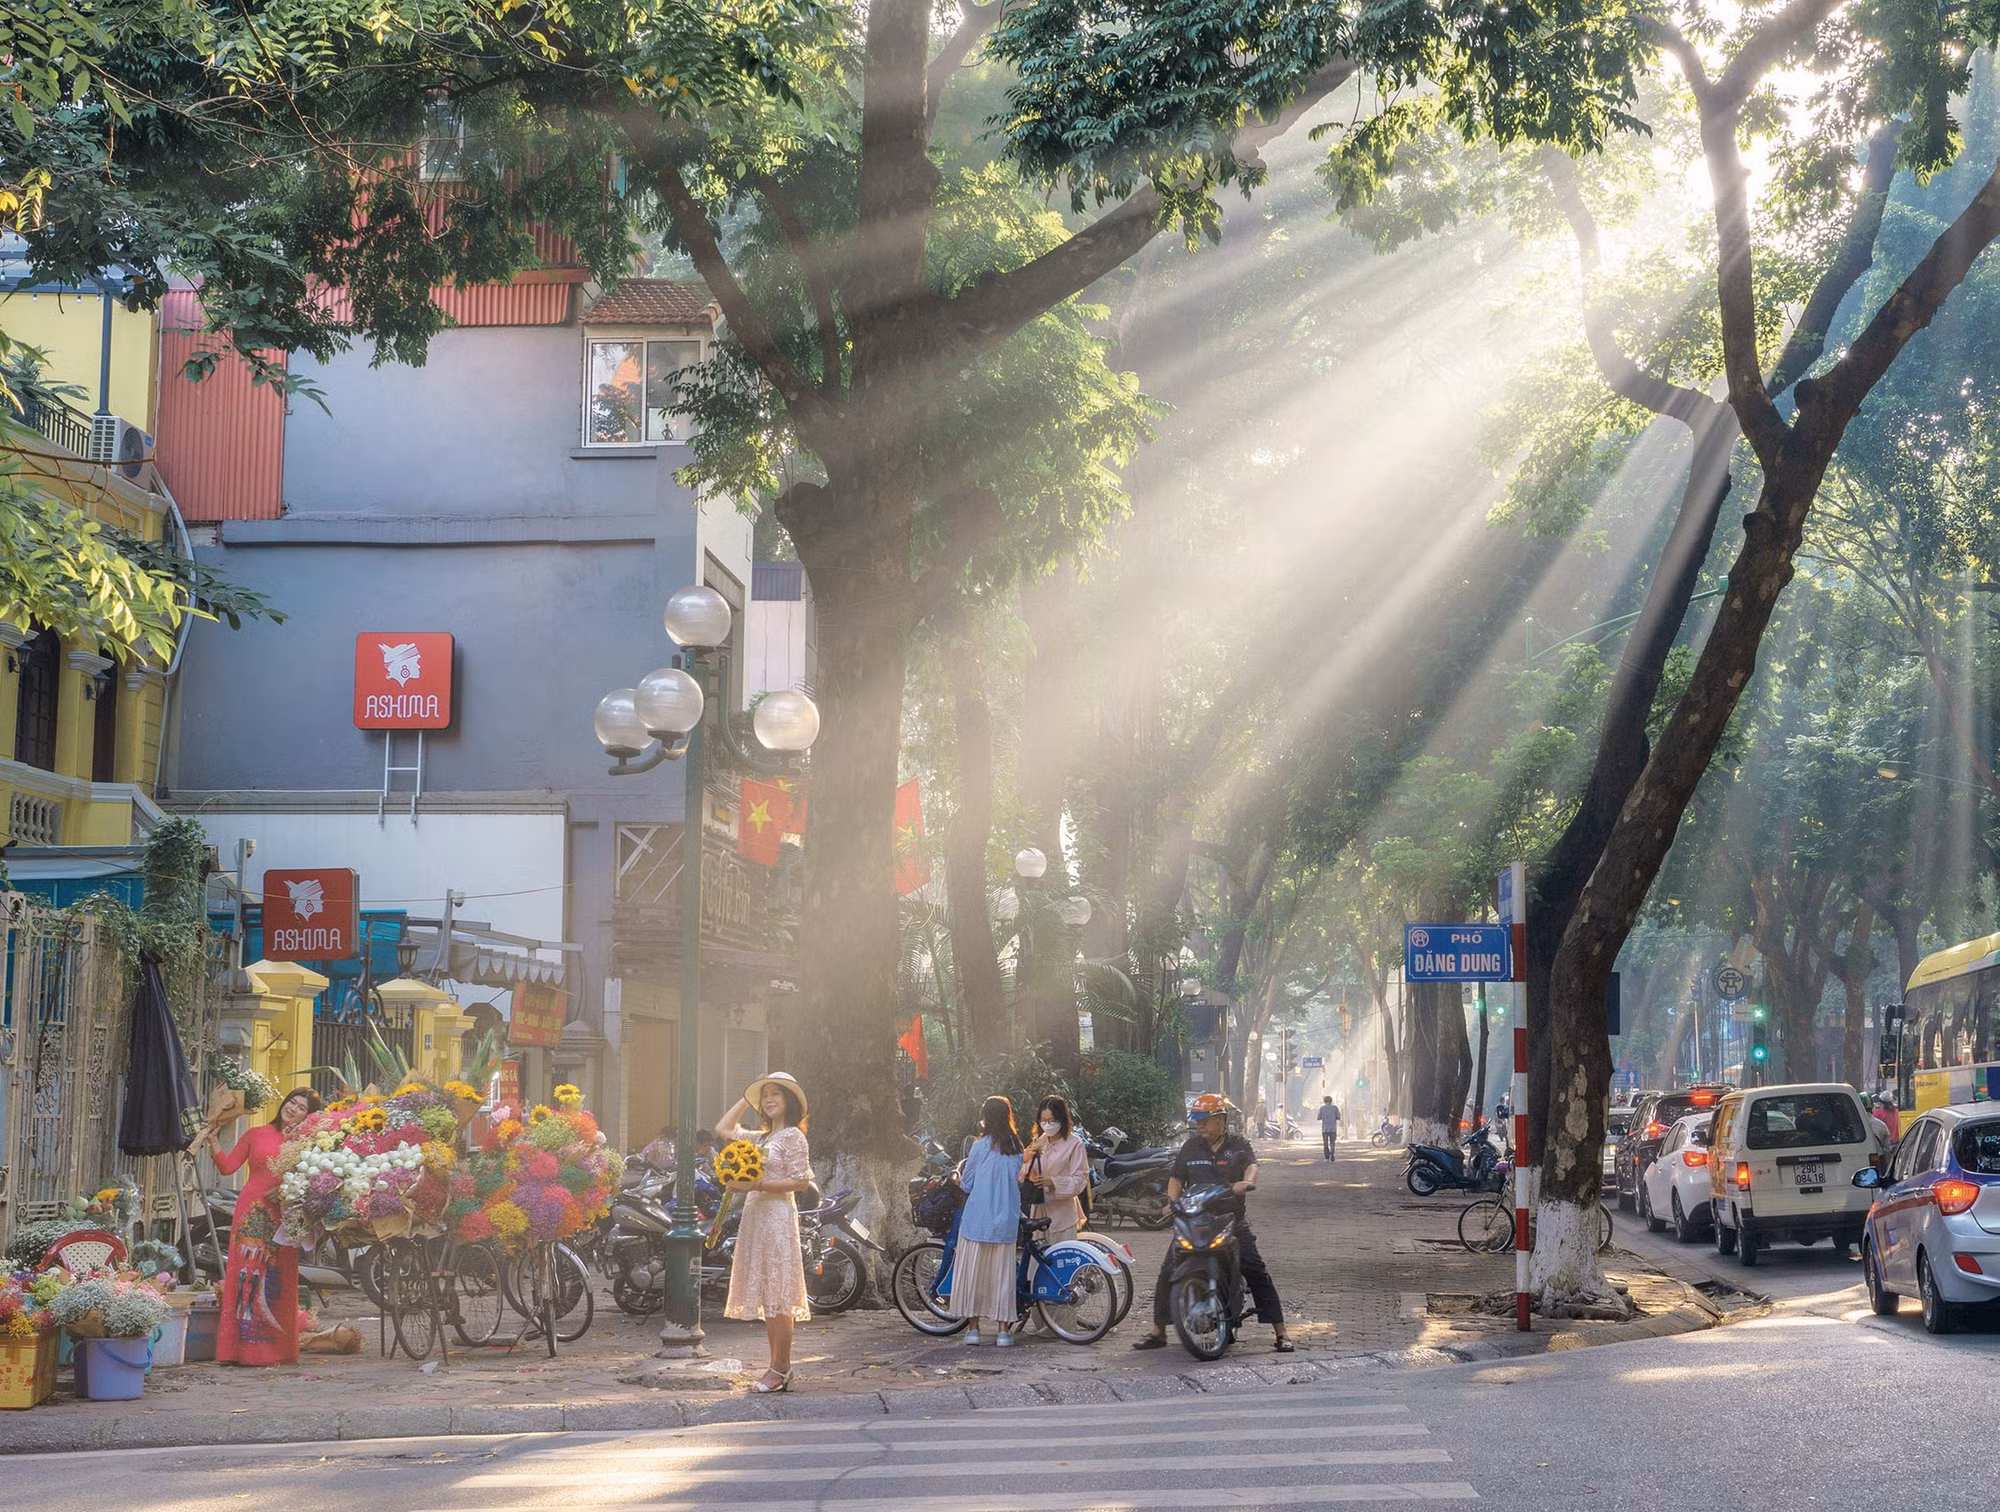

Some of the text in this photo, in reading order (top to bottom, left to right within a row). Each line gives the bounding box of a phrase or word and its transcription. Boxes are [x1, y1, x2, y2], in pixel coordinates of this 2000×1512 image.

[364, 694, 439, 718] ASHIMA
[272, 928, 342, 951] ASHIMA
[1451, 930, 1483, 944] PHỐ
[1414, 949, 1501, 976] ĐẶNG DUNG
[1801, 1164, 1817, 1174] 29D
